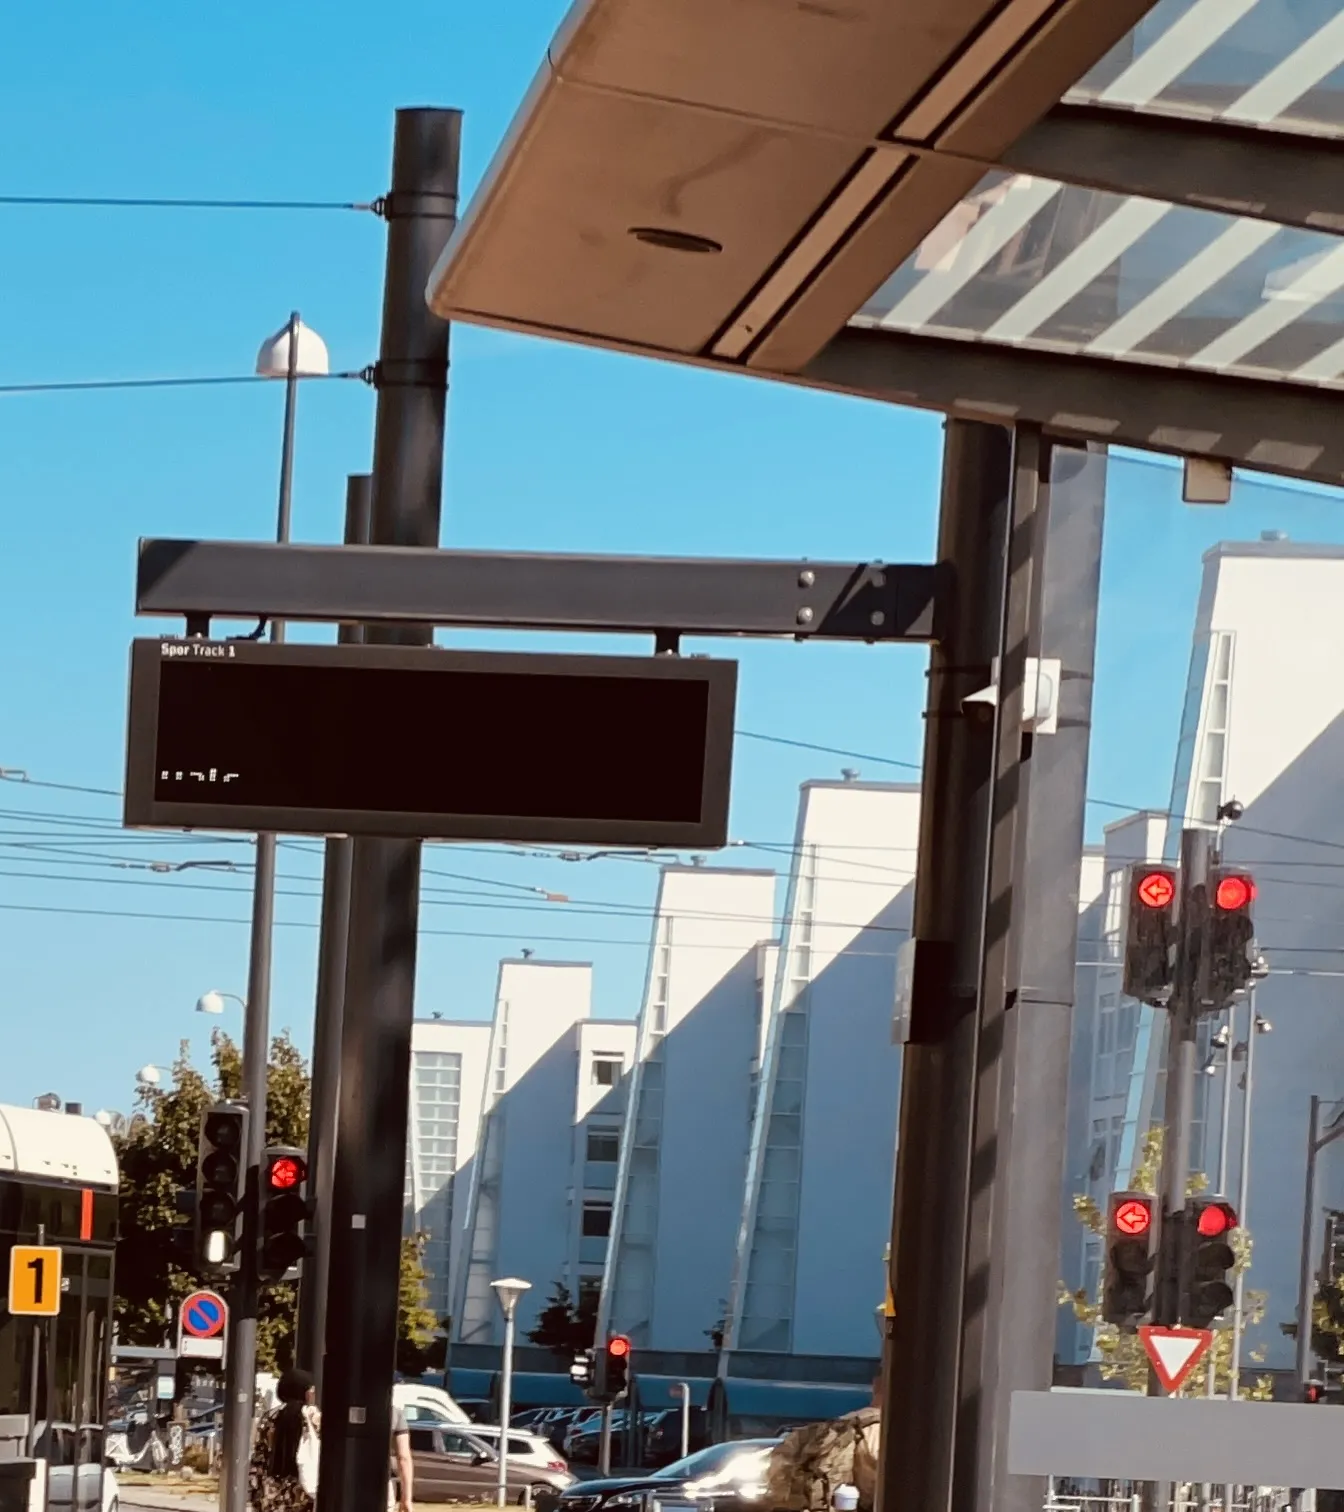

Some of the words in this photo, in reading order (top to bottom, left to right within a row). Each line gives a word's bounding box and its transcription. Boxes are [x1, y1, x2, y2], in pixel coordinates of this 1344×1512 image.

[161, 643, 189, 657] Spor
[193, 644, 225, 657] Track
[228, 645, 236, 658] 1
[27, 1257, 45, 1305] 1
